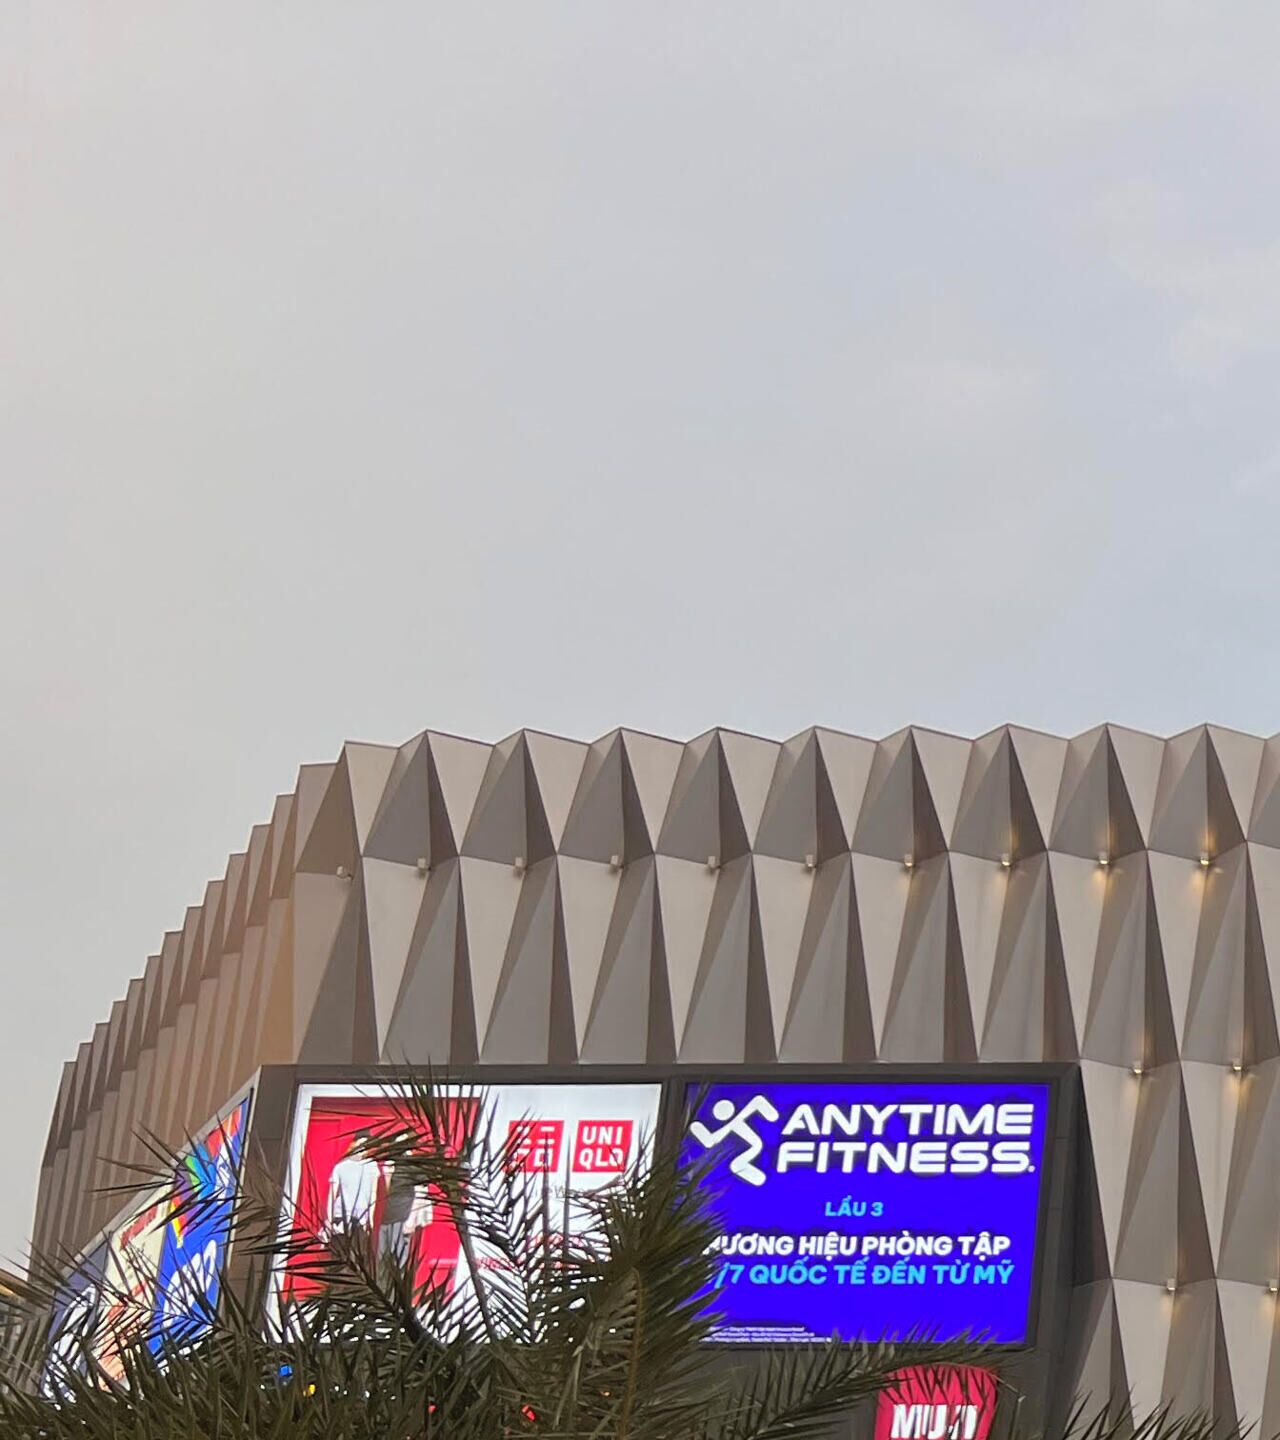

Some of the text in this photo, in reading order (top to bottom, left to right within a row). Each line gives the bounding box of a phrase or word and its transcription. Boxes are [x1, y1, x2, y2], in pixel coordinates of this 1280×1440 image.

[781, 1103, 1035, 1136] ANYTIME
[582, 1125, 623, 1145] UNI
[578, 1147, 624, 1170] QLO
[776, 1141, 1033, 1174] FITNESS
[870, 1201, 884, 1217] 3
[798, 1232, 857, 1261] HIỆU
[861, 1230, 953, 1256] PHÒNG
[958, 1232, 1011, 1261] TẬP
[749, 1255, 827, 1285] QUỐC
[833, 1255, 869, 1285] TẾ
[871, 1255, 926, 1285] ĐẾN
[932, 1258, 970, 1285] TỪ
[972, 1259, 1016, 1285] MỸ
